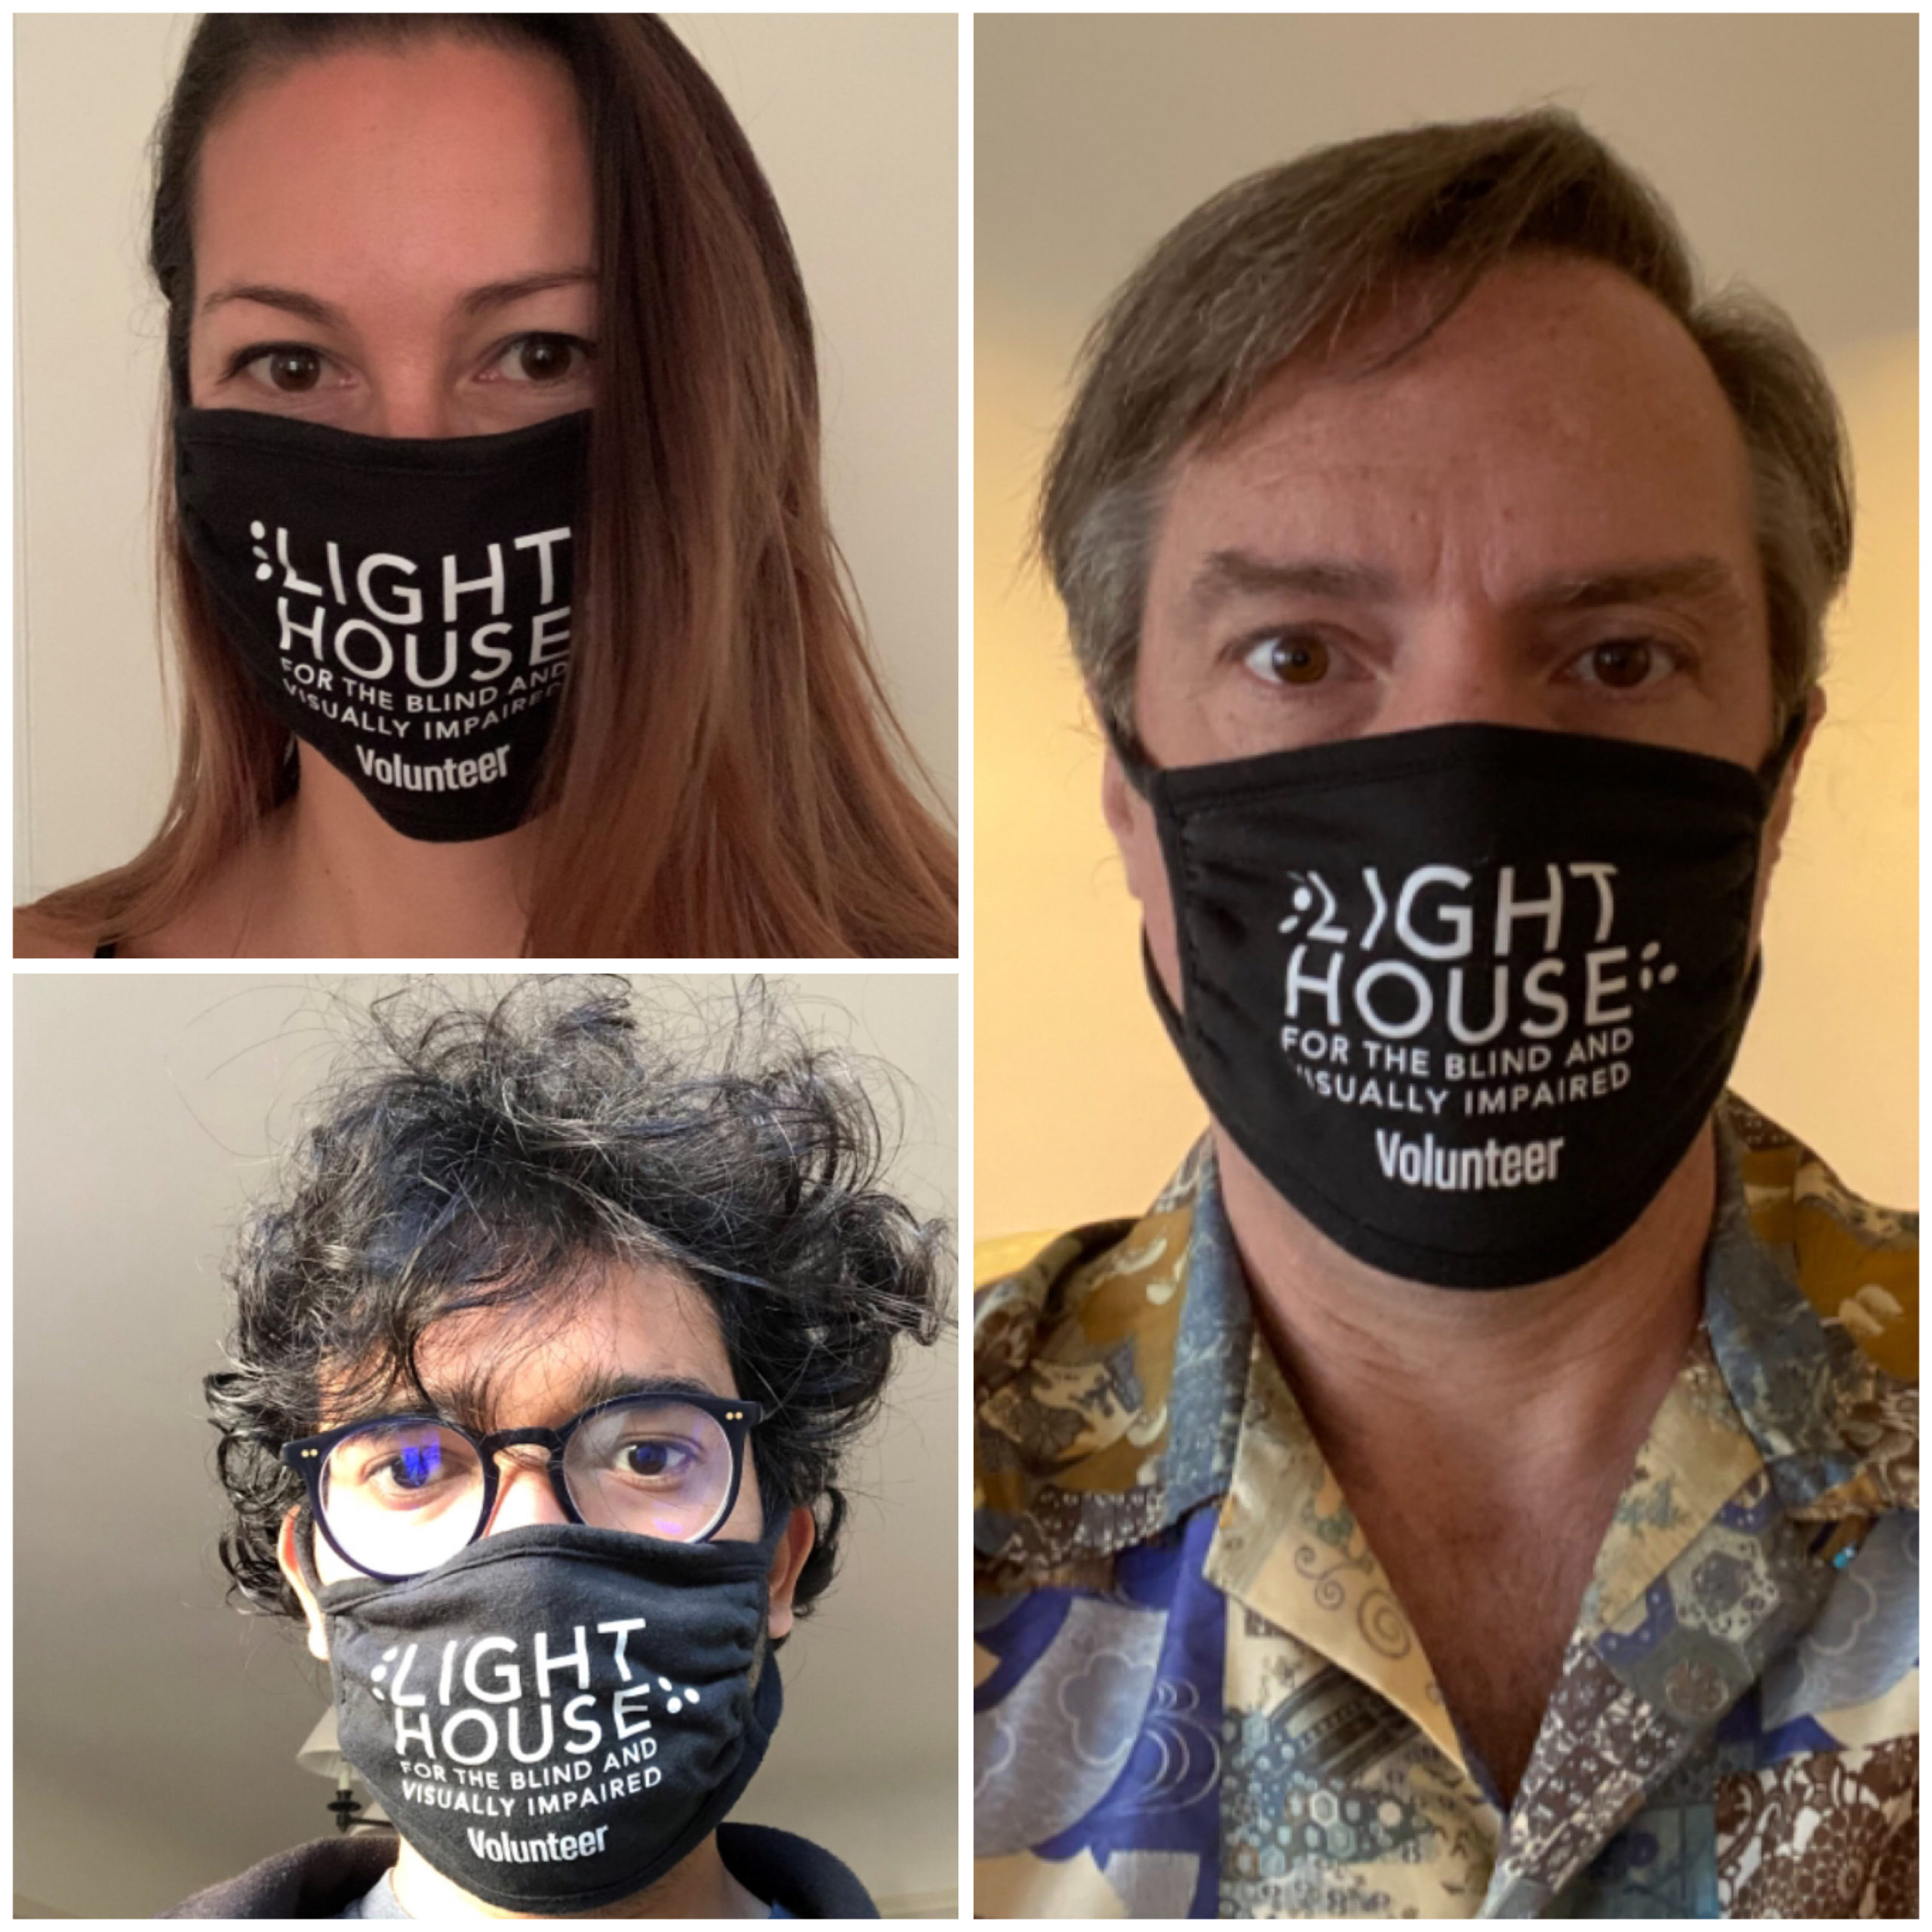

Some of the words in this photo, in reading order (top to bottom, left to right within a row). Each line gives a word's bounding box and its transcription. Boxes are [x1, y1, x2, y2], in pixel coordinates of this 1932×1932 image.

[277, 526, 571, 625] LIGHT
[277, 596, 571, 688] HOUSE
[280, 657, 333, 691] FOR
[342, 676, 394, 710] THE
[406, 686, 498, 713] BLIND
[507, 660, 568, 694] AND
[282, 678, 410, 738] VISUALLY
[355, 744, 510, 792] Volunteer
[1306, 862, 1619, 961] LIGHT
[1284, 944, 1632, 1046] HOUSE
[1281, 1025, 1349, 1065] FOR
[1362, 1040, 1430, 1078] THE
[1444, 1044, 1552, 1081] BLIND
[1564, 1027, 1634, 1069] AND
[1296, 1063, 1449, 1116] ISUALLY
[1463, 1061, 1631, 1116] IMPAIRED
[1374, 1128, 1564, 1191] Volunteer
[391, 1618, 646, 1706] LIGHT
[394, 1683, 651, 1765] HOUSE
[400, 1761, 447, 1783] FOR
[453, 1767, 500, 1790] THE
[510, 1760, 593, 1790] BLIND
[602, 1737, 657, 1774] AND
[402, 1779, 515, 1817] VISUALLY
[528, 1766, 663, 1816] IMPAIRED
[467, 1825, 609, 1863] Volunteer
